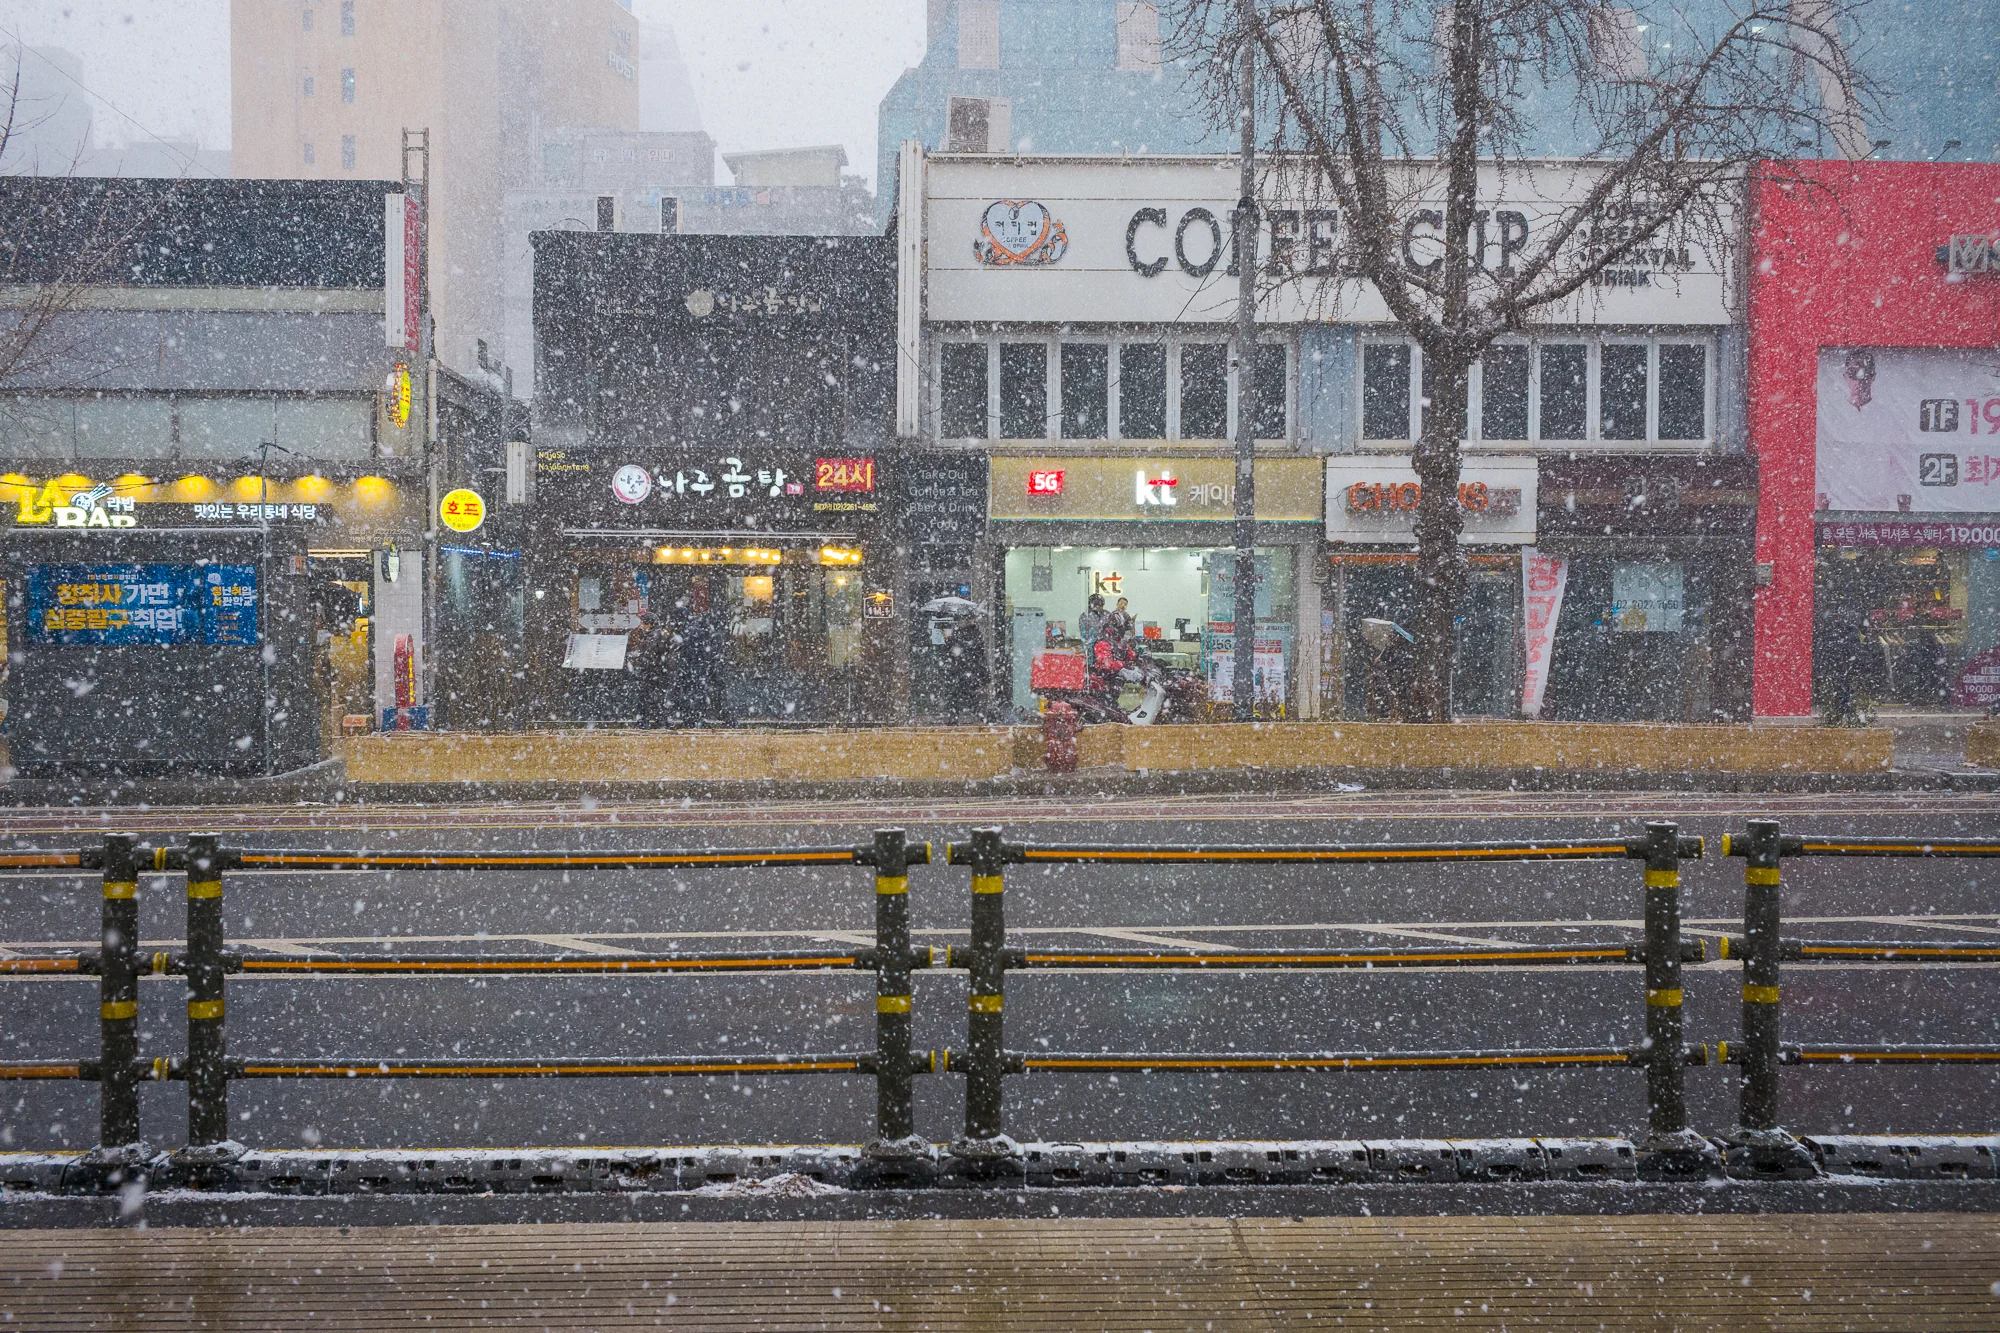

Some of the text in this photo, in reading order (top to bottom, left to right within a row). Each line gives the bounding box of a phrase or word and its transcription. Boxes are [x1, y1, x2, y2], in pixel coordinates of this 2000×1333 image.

[659, 457, 788, 498] 나주곰탕
[818, 463, 873, 489] 24시
[1924, 457, 1956, 483] 2F
[1034, 473, 1058, 491] 5G
[1135, 471, 1236, 506] kt 케이
[17, 480, 69, 523] LA
[106, 495, 136, 512] 라밥
[194, 504, 234, 519] 맛있는
[290, 504, 317, 519] 식당
[445, 501, 480, 516] 호프
[125, 584, 169, 604] 가면
[1095, 572, 1121, 594] kt
[133, 608, 183, 630] 취업!
